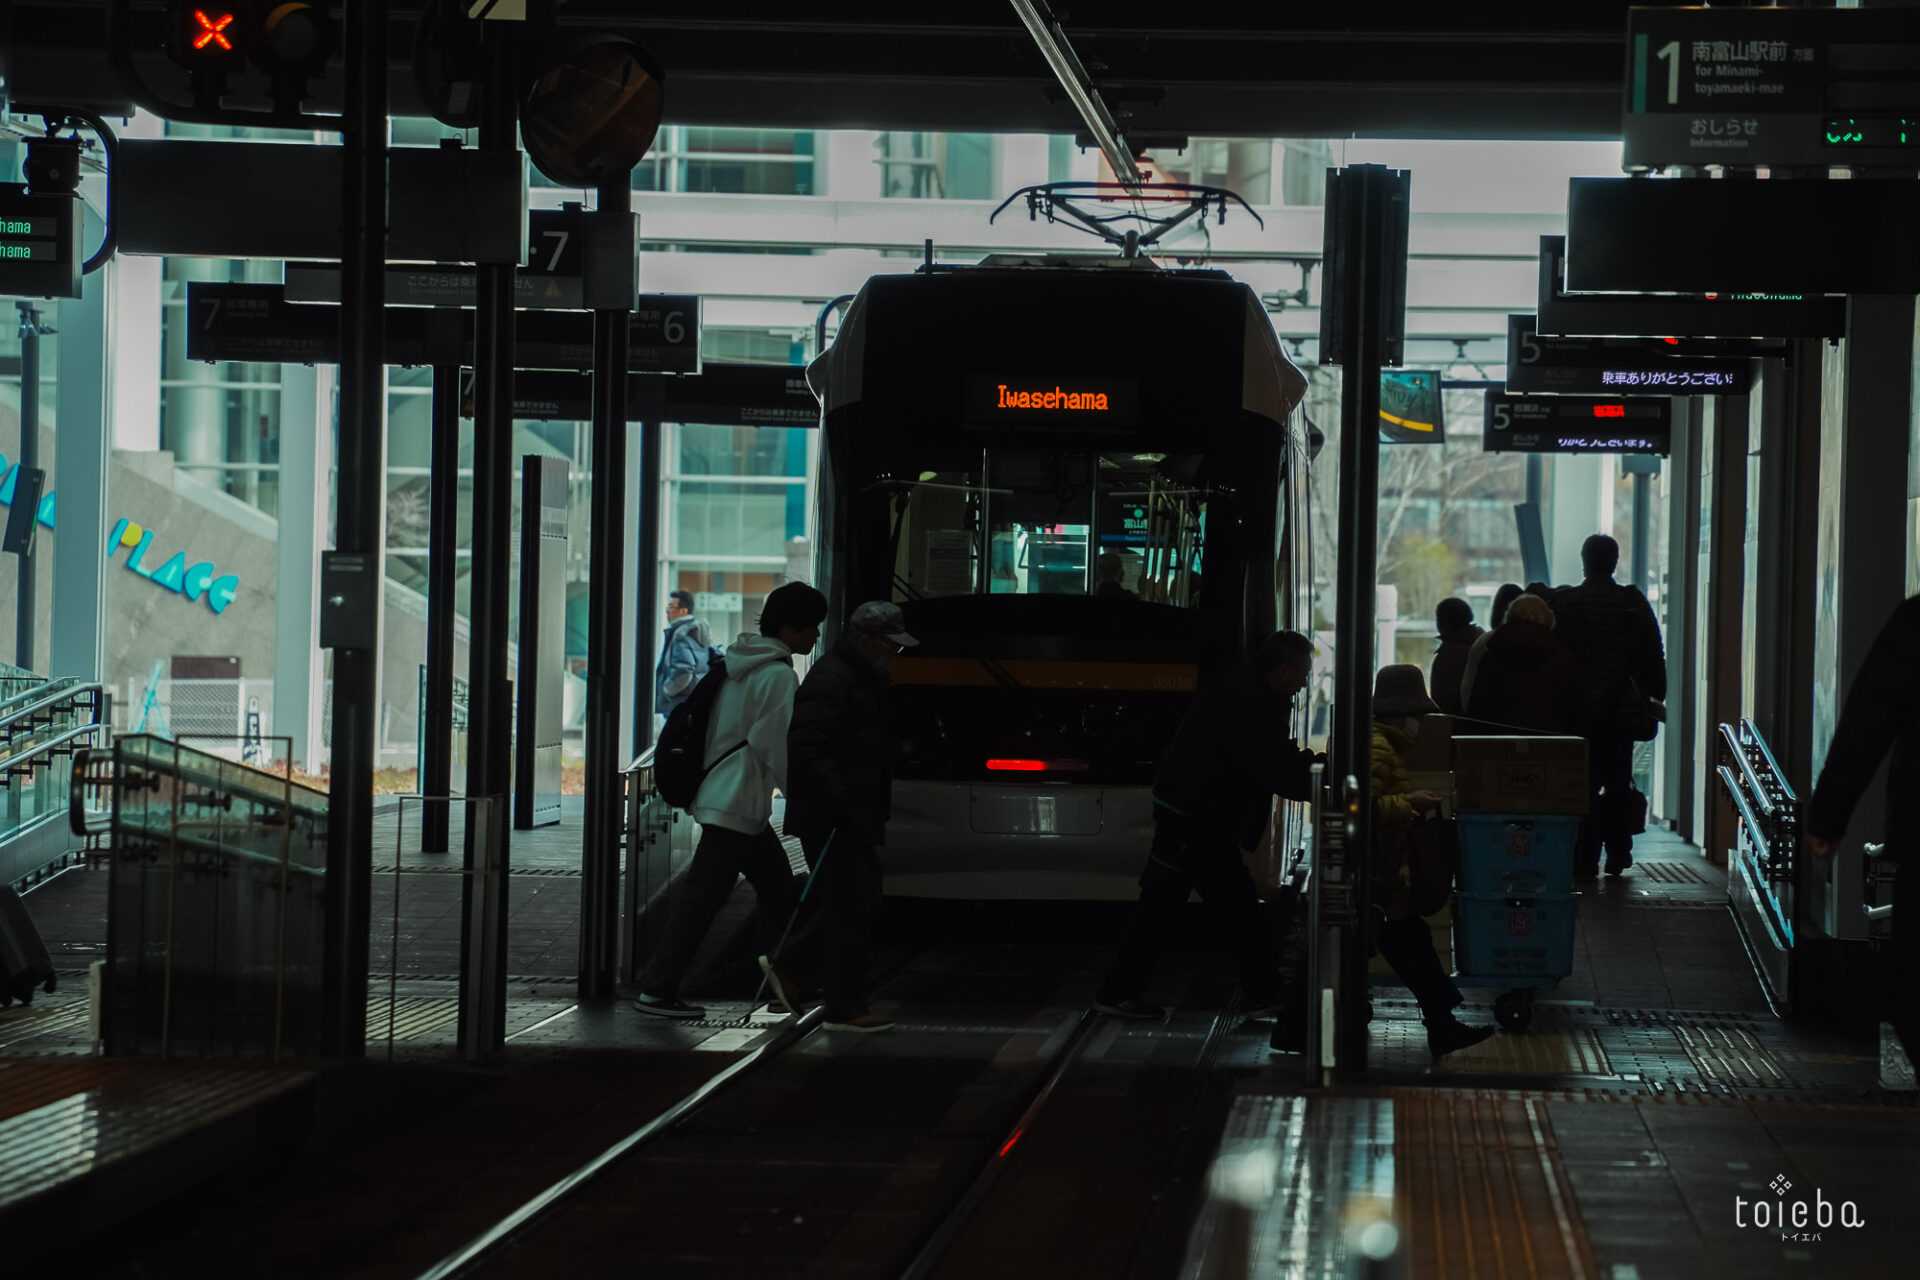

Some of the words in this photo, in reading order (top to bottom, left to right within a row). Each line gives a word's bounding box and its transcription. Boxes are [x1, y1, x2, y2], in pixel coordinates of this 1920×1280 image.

[1692, 41, 1787, 62] 南富山駅前
[1657, 41, 1680, 104] 1
[1695, 64, 1712, 76] for
[1695, 83, 1784, 96] toyamaeki-mae
[1690, 118, 1758, 136] おしらせ
[200, 298, 221, 331] 7
[664, 311, 685, 343] 6
[1521, 331, 1541, 363] 5
[997, 384, 1109, 410] Iwasehama
[1494, 403, 1511, 430] 5
[108, 518, 239, 614] PLACE
